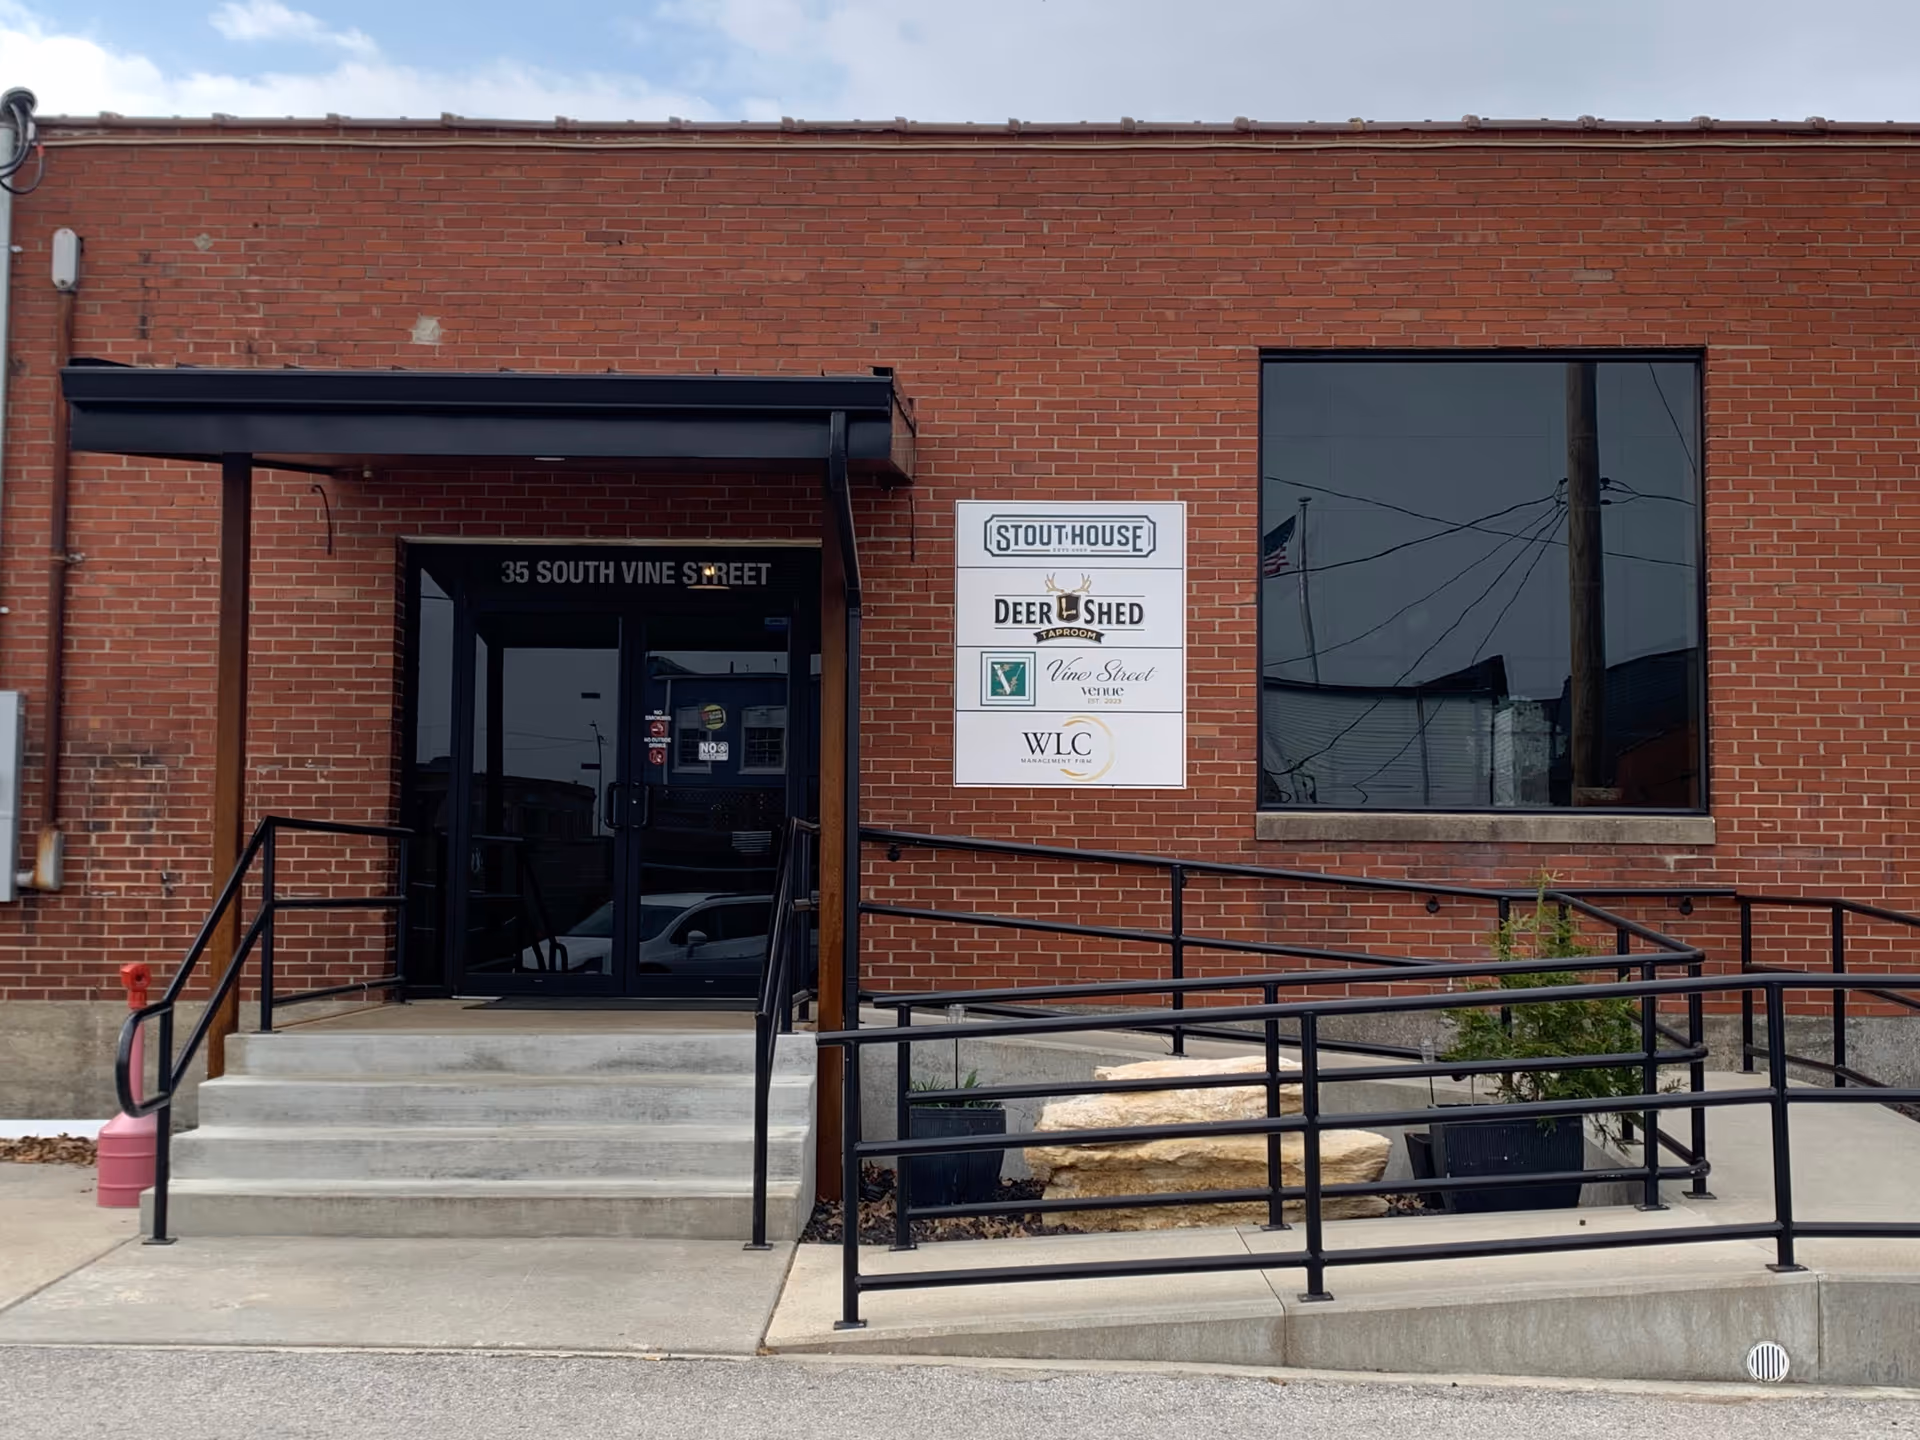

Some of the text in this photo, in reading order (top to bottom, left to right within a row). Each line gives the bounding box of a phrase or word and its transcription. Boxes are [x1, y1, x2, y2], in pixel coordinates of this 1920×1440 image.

[501, 560, 771, 586] 35 SOUTH VINE STREET
[994, 598, 1053, 625] DEER
[1083, 598, 1144, 625] SHED
[1040, 628, 1097, 640] TAPROOM
[1046, 656, 1158, 682] Vine Street
[1080, 686, 1125, 697] venue
[701, 742, 717, 753] NO
[1021, 731, 1092, 756] WLC
